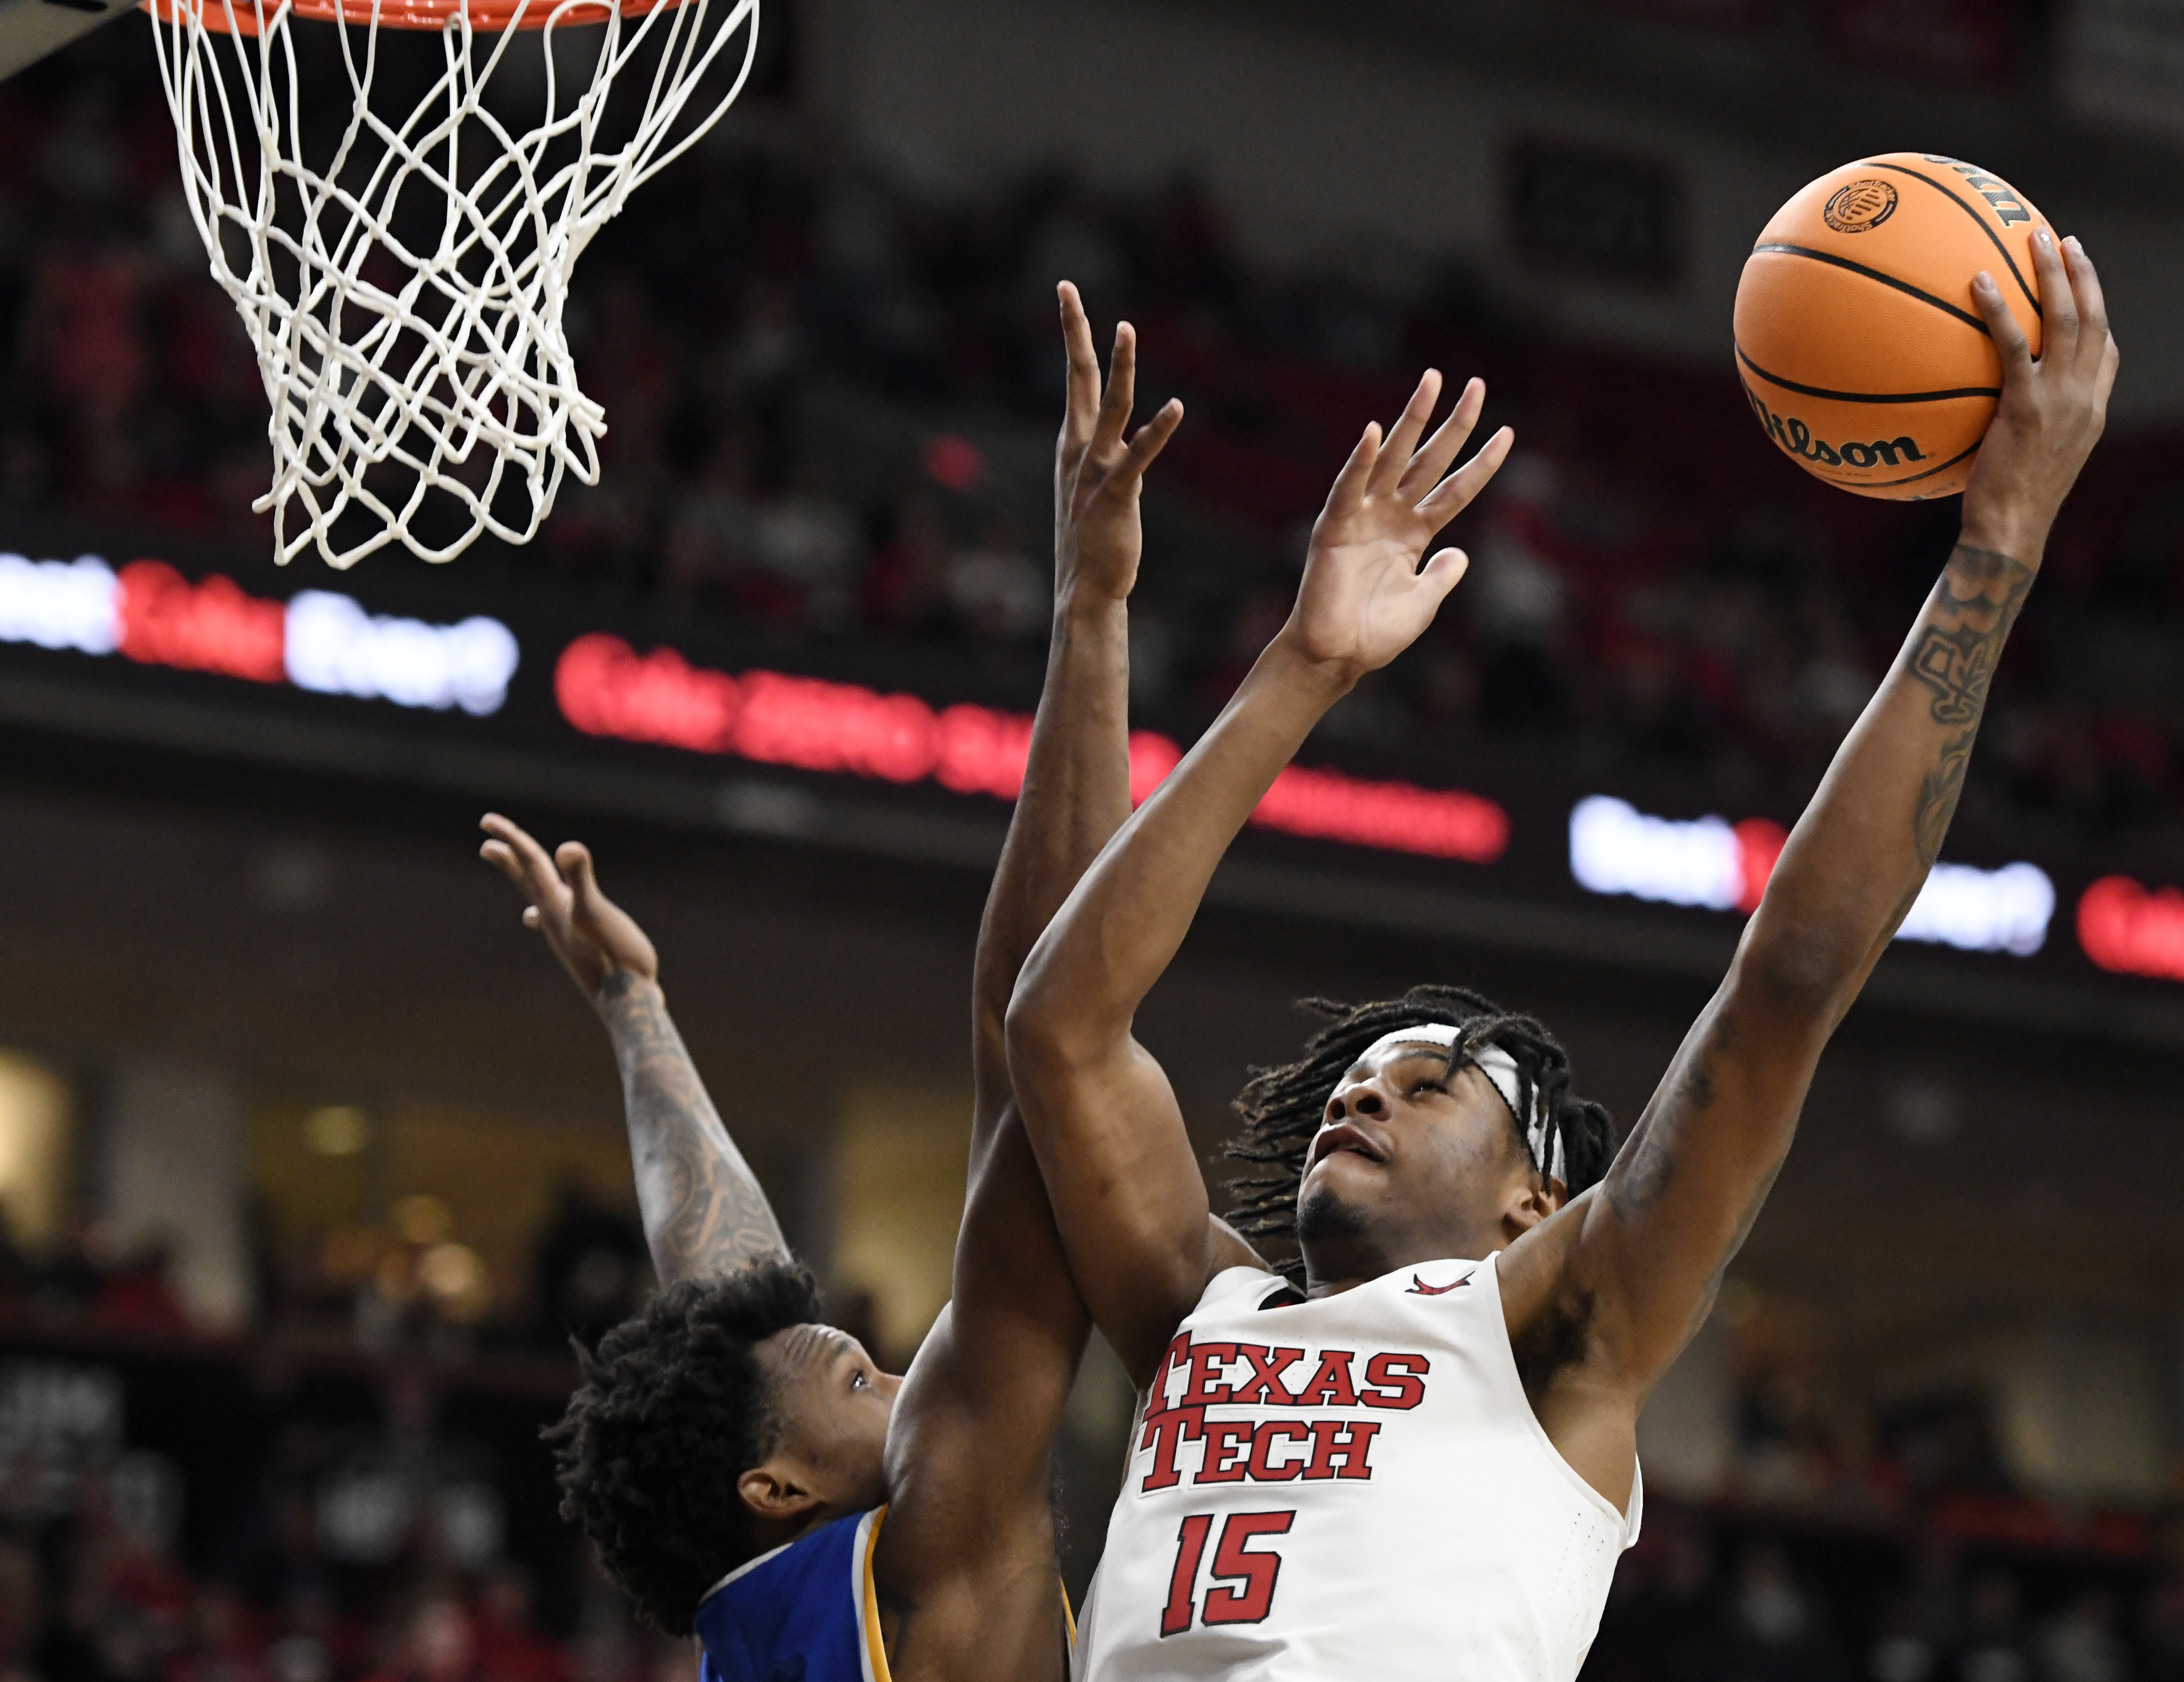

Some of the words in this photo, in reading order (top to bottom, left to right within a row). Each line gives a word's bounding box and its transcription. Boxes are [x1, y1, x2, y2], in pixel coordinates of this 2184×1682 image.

[1146, 1331, 1430, 1417] TEXAS
[1140, 1406, 1382, 1494] TECH
[1160, 1510, 1297, 1638] 15
